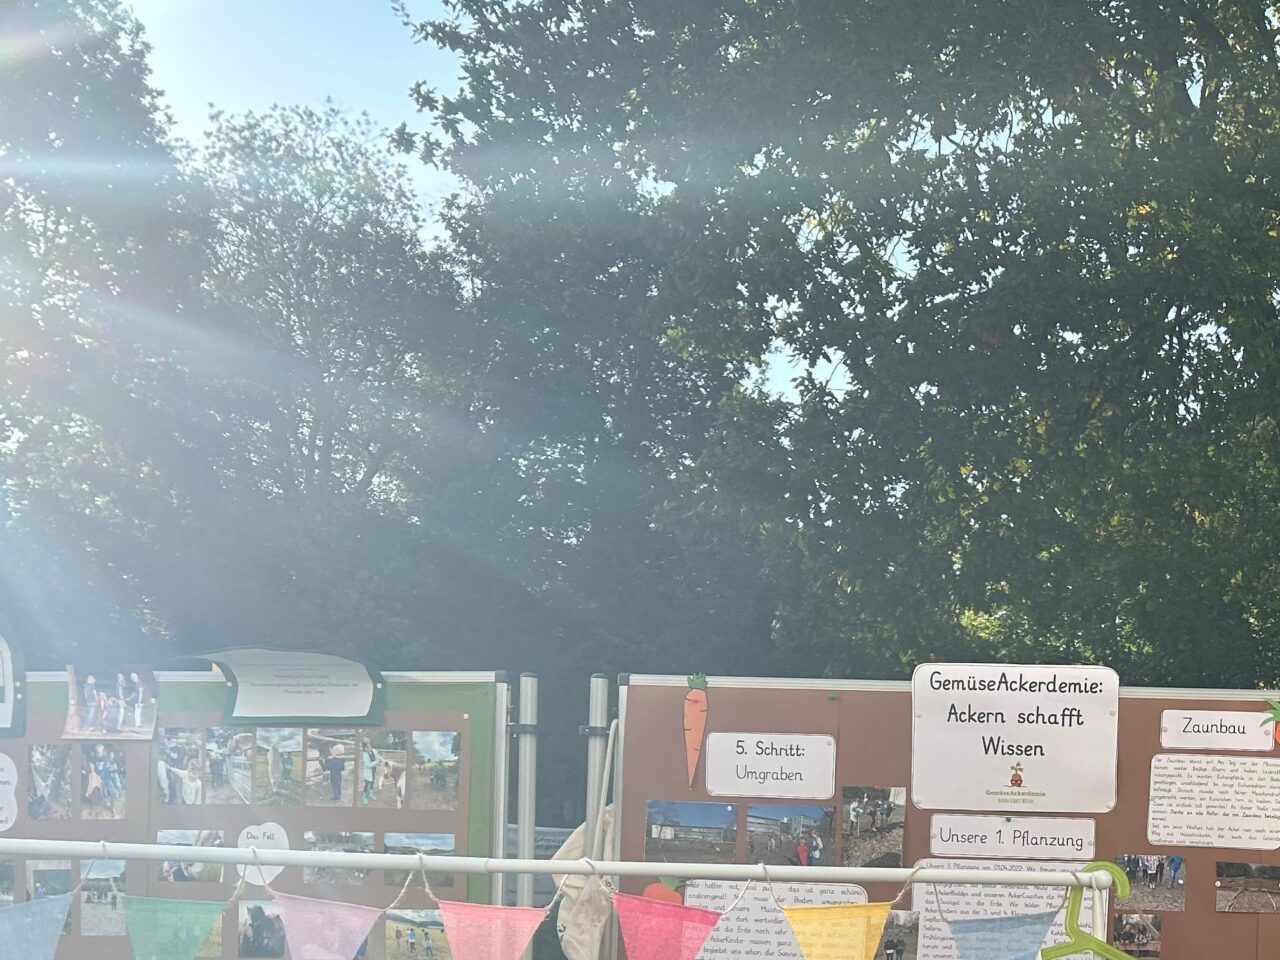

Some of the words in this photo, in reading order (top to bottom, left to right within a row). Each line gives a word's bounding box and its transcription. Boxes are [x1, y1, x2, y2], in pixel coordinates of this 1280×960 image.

[930, 671, 1103, 694] GemüseAckerdemie:
[947, 703, 1006, 723] Ackern
[1017, 706, 1084, 727] schafft
[1182, 717, 1246, 735] Zaunbau
[736, 740, 747, 755] 5.
[755, 740, 805, 757] Schritt:
[982, 736, 1045, 756] Wissen
[736, 764, 803, 784] Umgraben
[940, 827, 987, 844] Unsere
[996, 829, 1005, 846] 1.
[1013, 830, 1083, 851] Pflanzung
